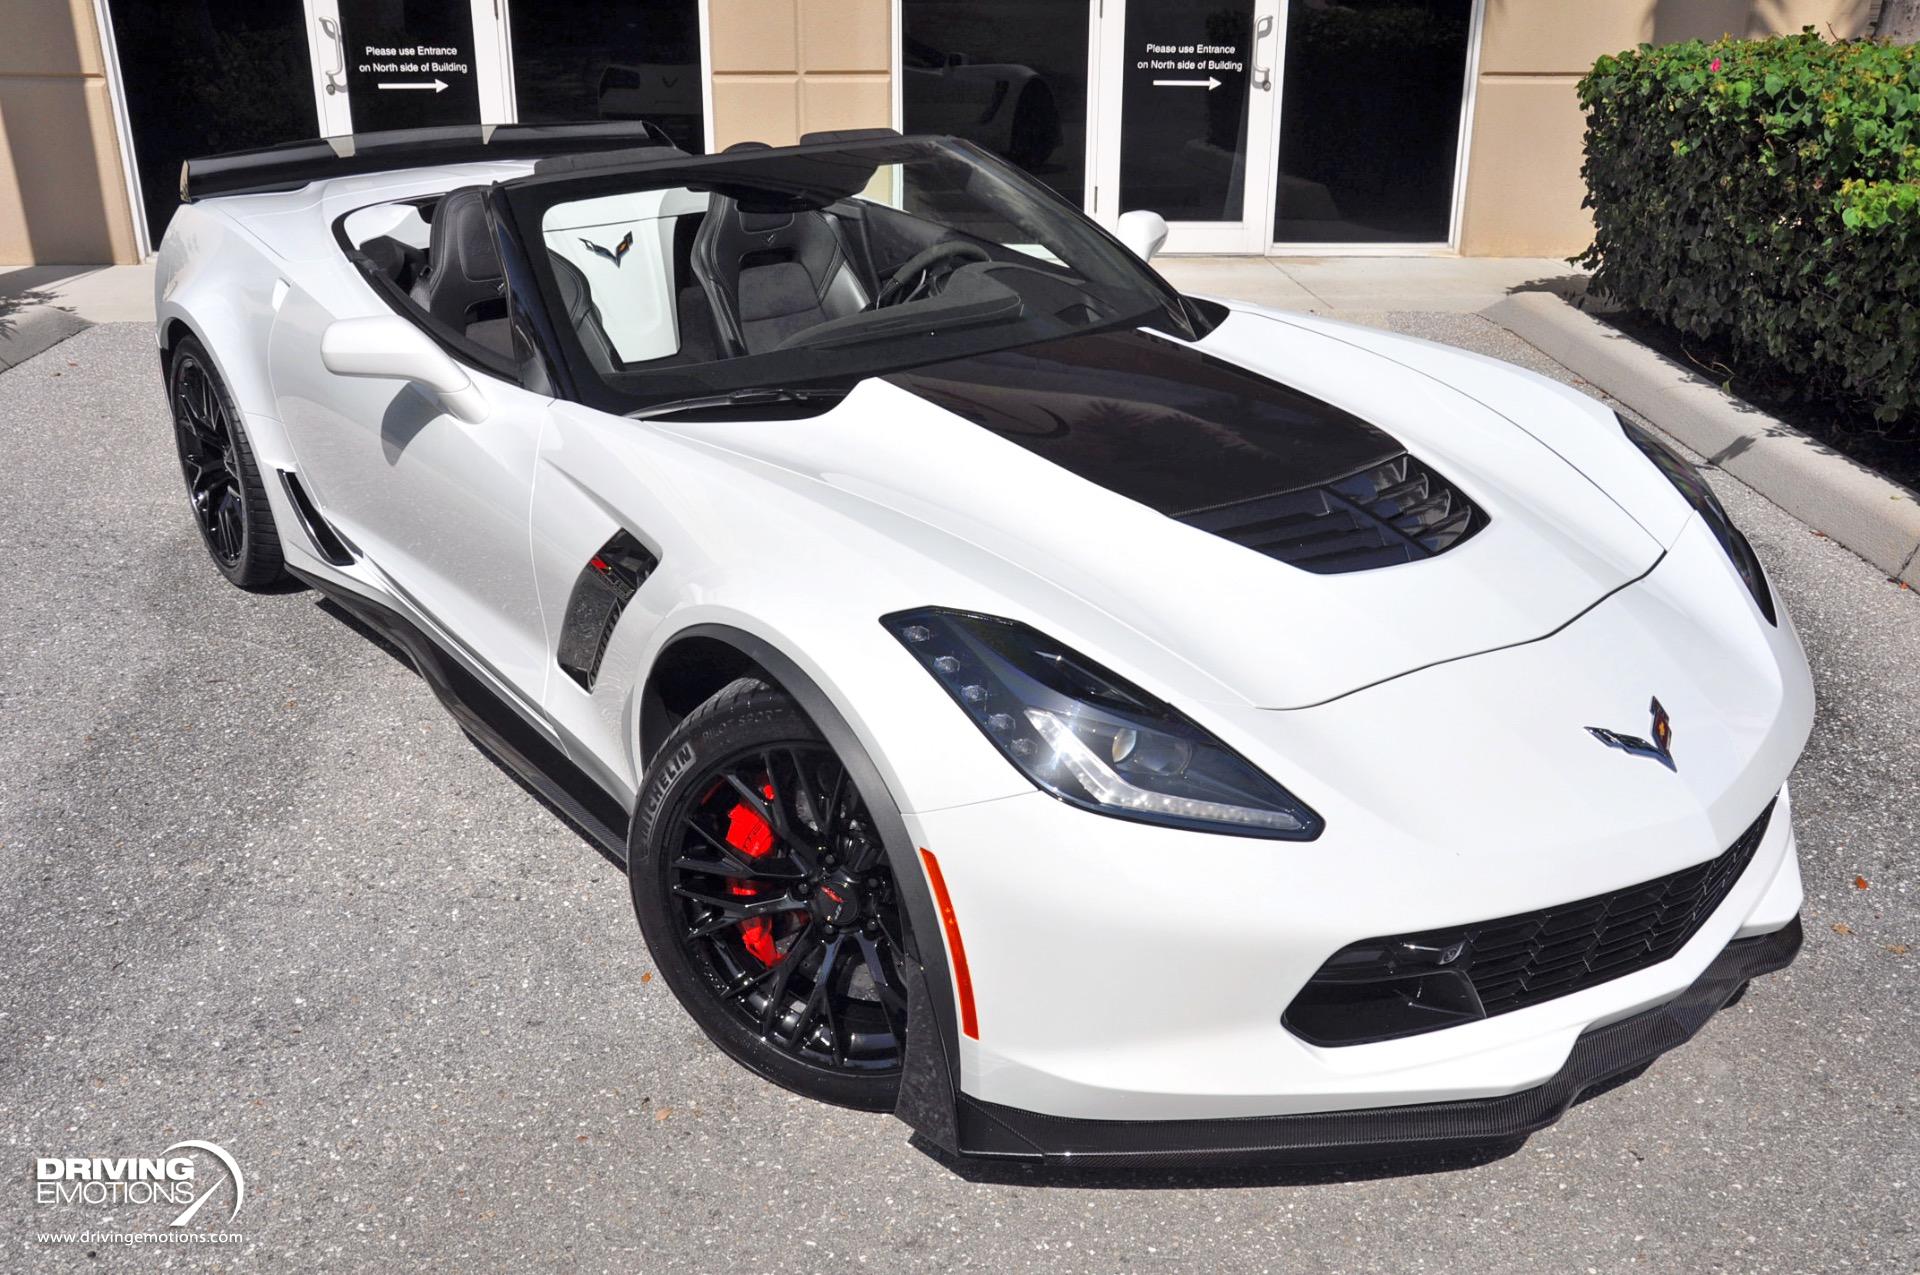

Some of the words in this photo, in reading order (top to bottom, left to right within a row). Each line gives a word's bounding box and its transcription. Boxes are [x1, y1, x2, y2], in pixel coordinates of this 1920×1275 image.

[365, 46, 396, 56] Please
[399, 48, 415, 56] use
[417, 46, 457, 56] Entrance
[1146, 44, 1176, 54] Please
[1178, 46, 1194, 54] use
[1197, 44, 1235, 54] Entrance
[359, 64, 371, 72] on
[373, 62, 398, 72] North
[400, 62, 419, 72] side
[421, 63, 430, 72] of
[432, 62, 468, 74] Building
[1137, 61, 1148, 69] on
[1151, 60, 1175, 69] North
[1177, 60, 1195, 69] side
[1197, 60, 1206, 69] of
[1208, 60, 1243, 72] Building
[640, 743, 693, 851] MICHELIN
